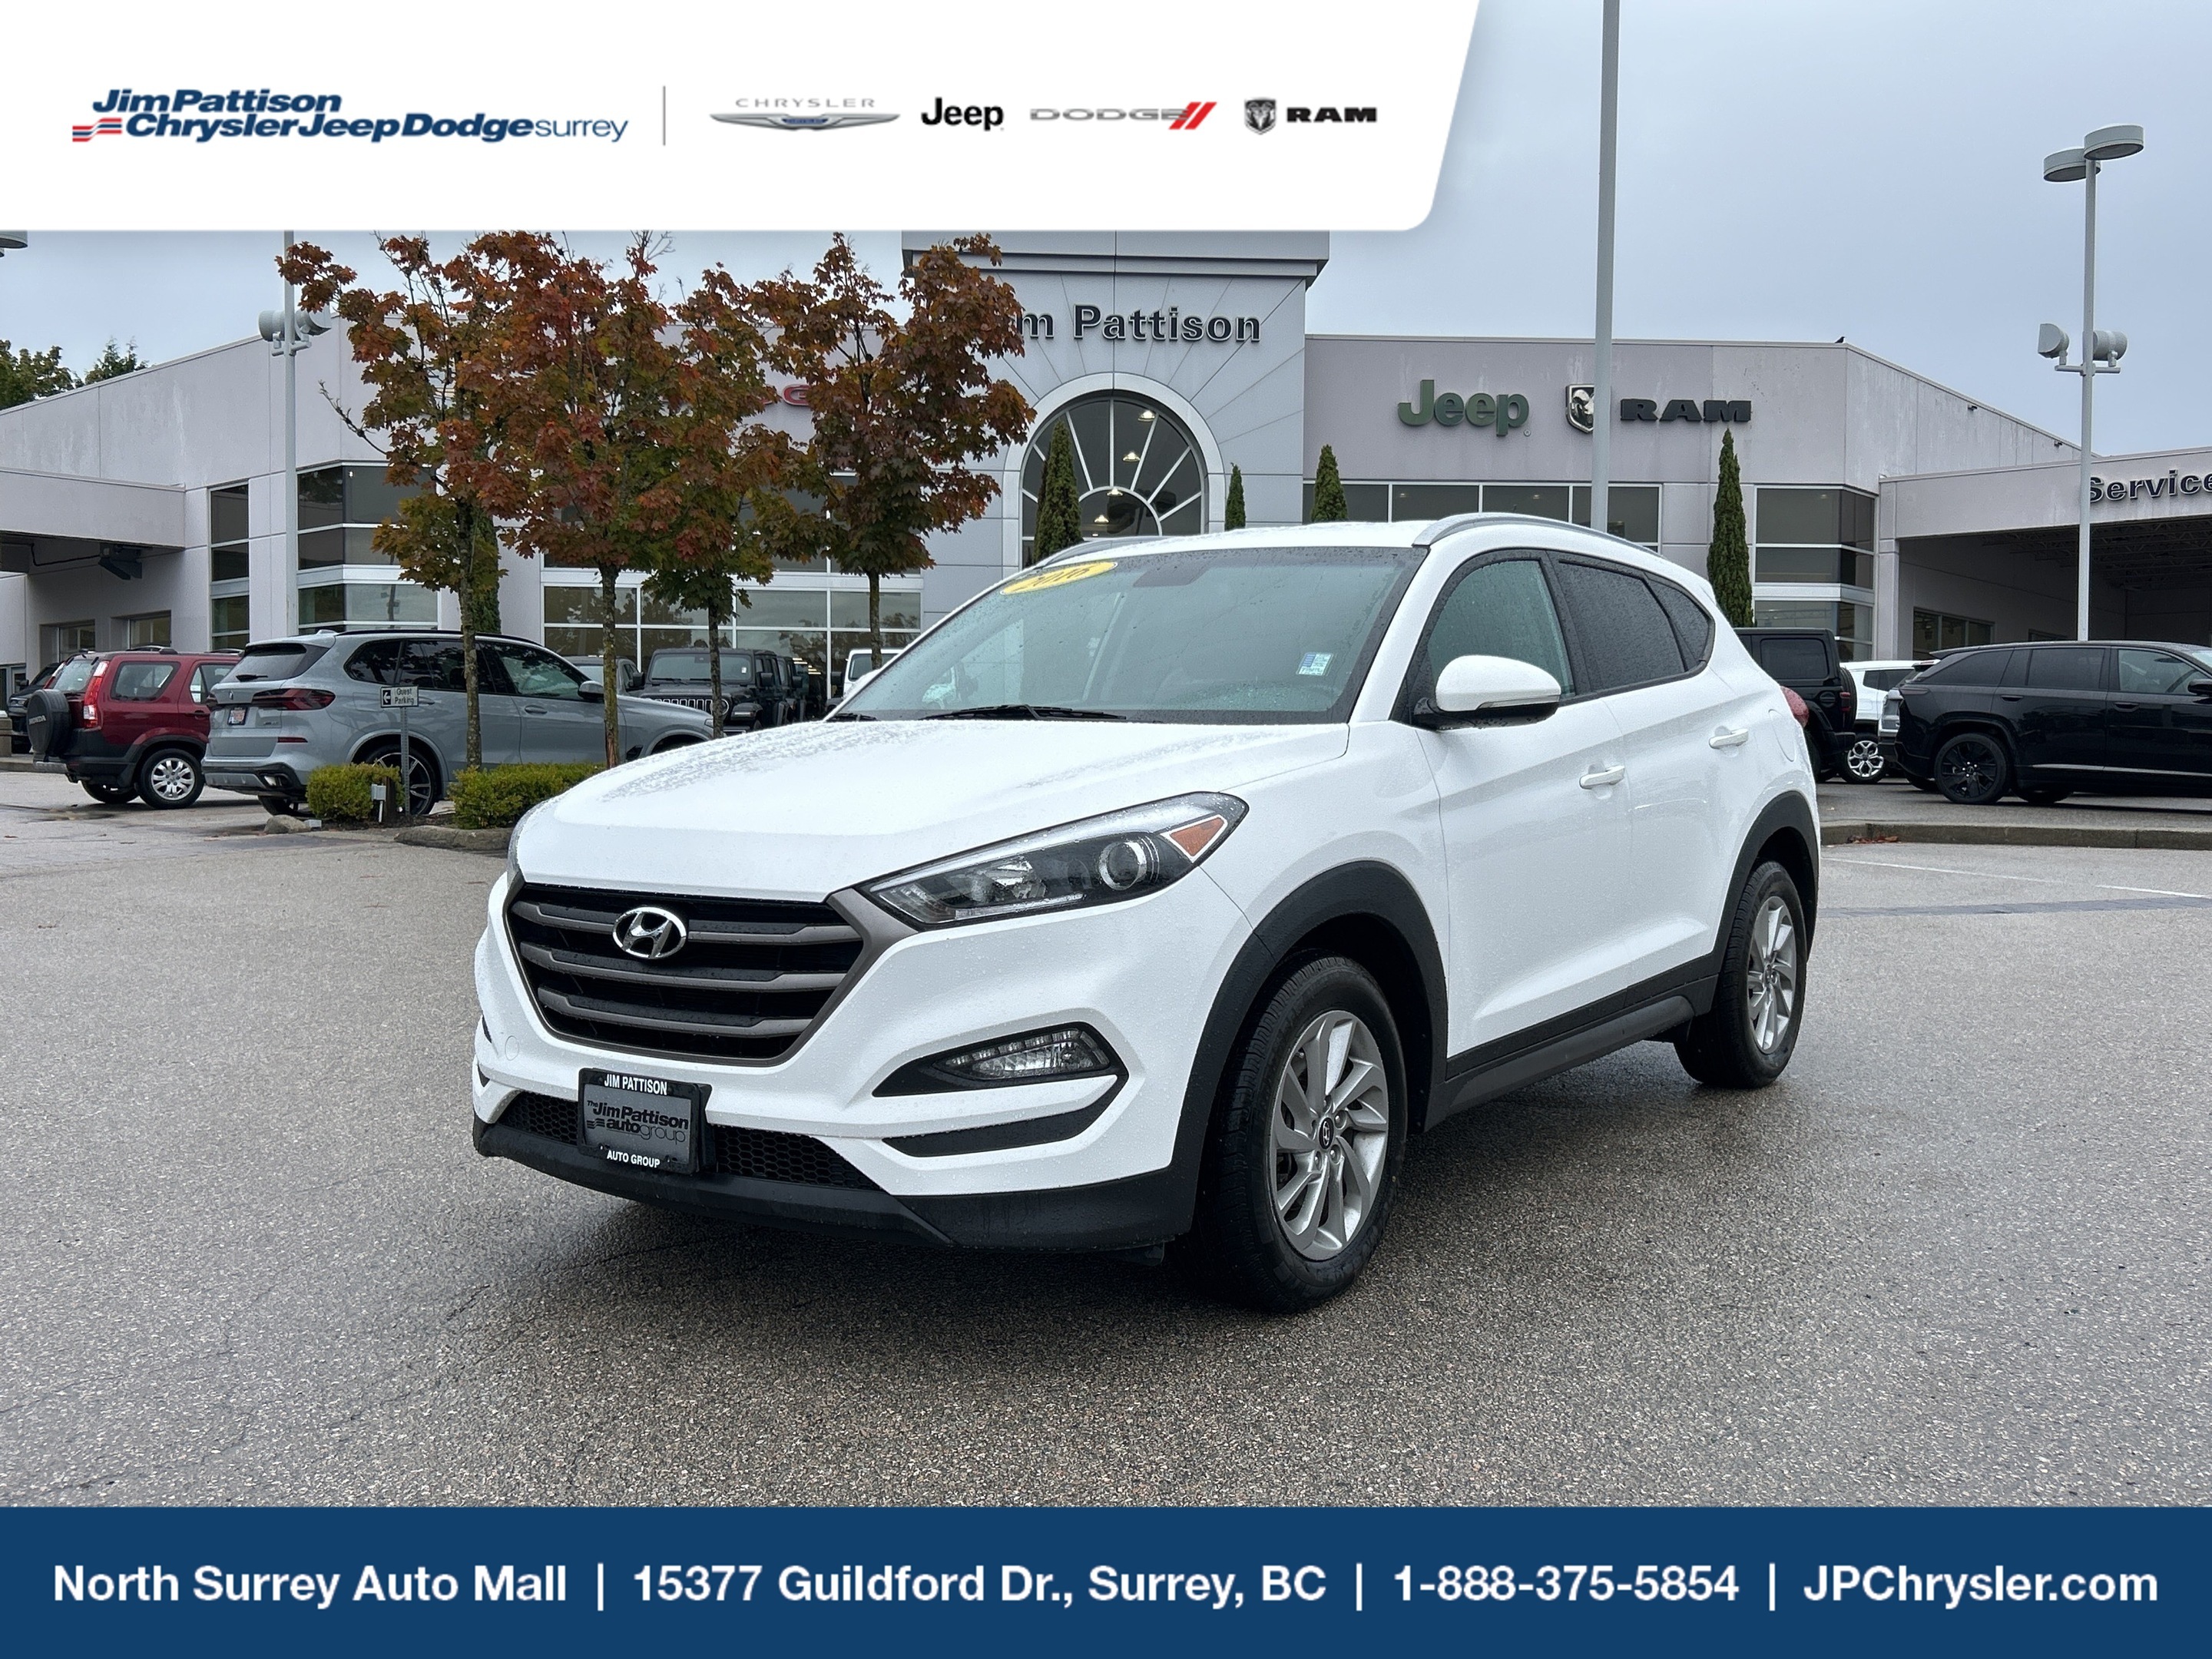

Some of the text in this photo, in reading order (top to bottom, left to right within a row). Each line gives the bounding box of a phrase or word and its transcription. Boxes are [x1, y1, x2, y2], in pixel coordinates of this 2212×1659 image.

[1074, 304, 1261, 343] Pattison
[1397, 379, 1530, 436] Jeep
[1620, 398, 1752, 423] RAM
[394, 697, 415, 705] Parking
[396, 687, 412, 696] Guest
[604, 1074, 667, 1095] JIM PATTISON
[606, 1150, 661, 1168] AUTO GROUP
